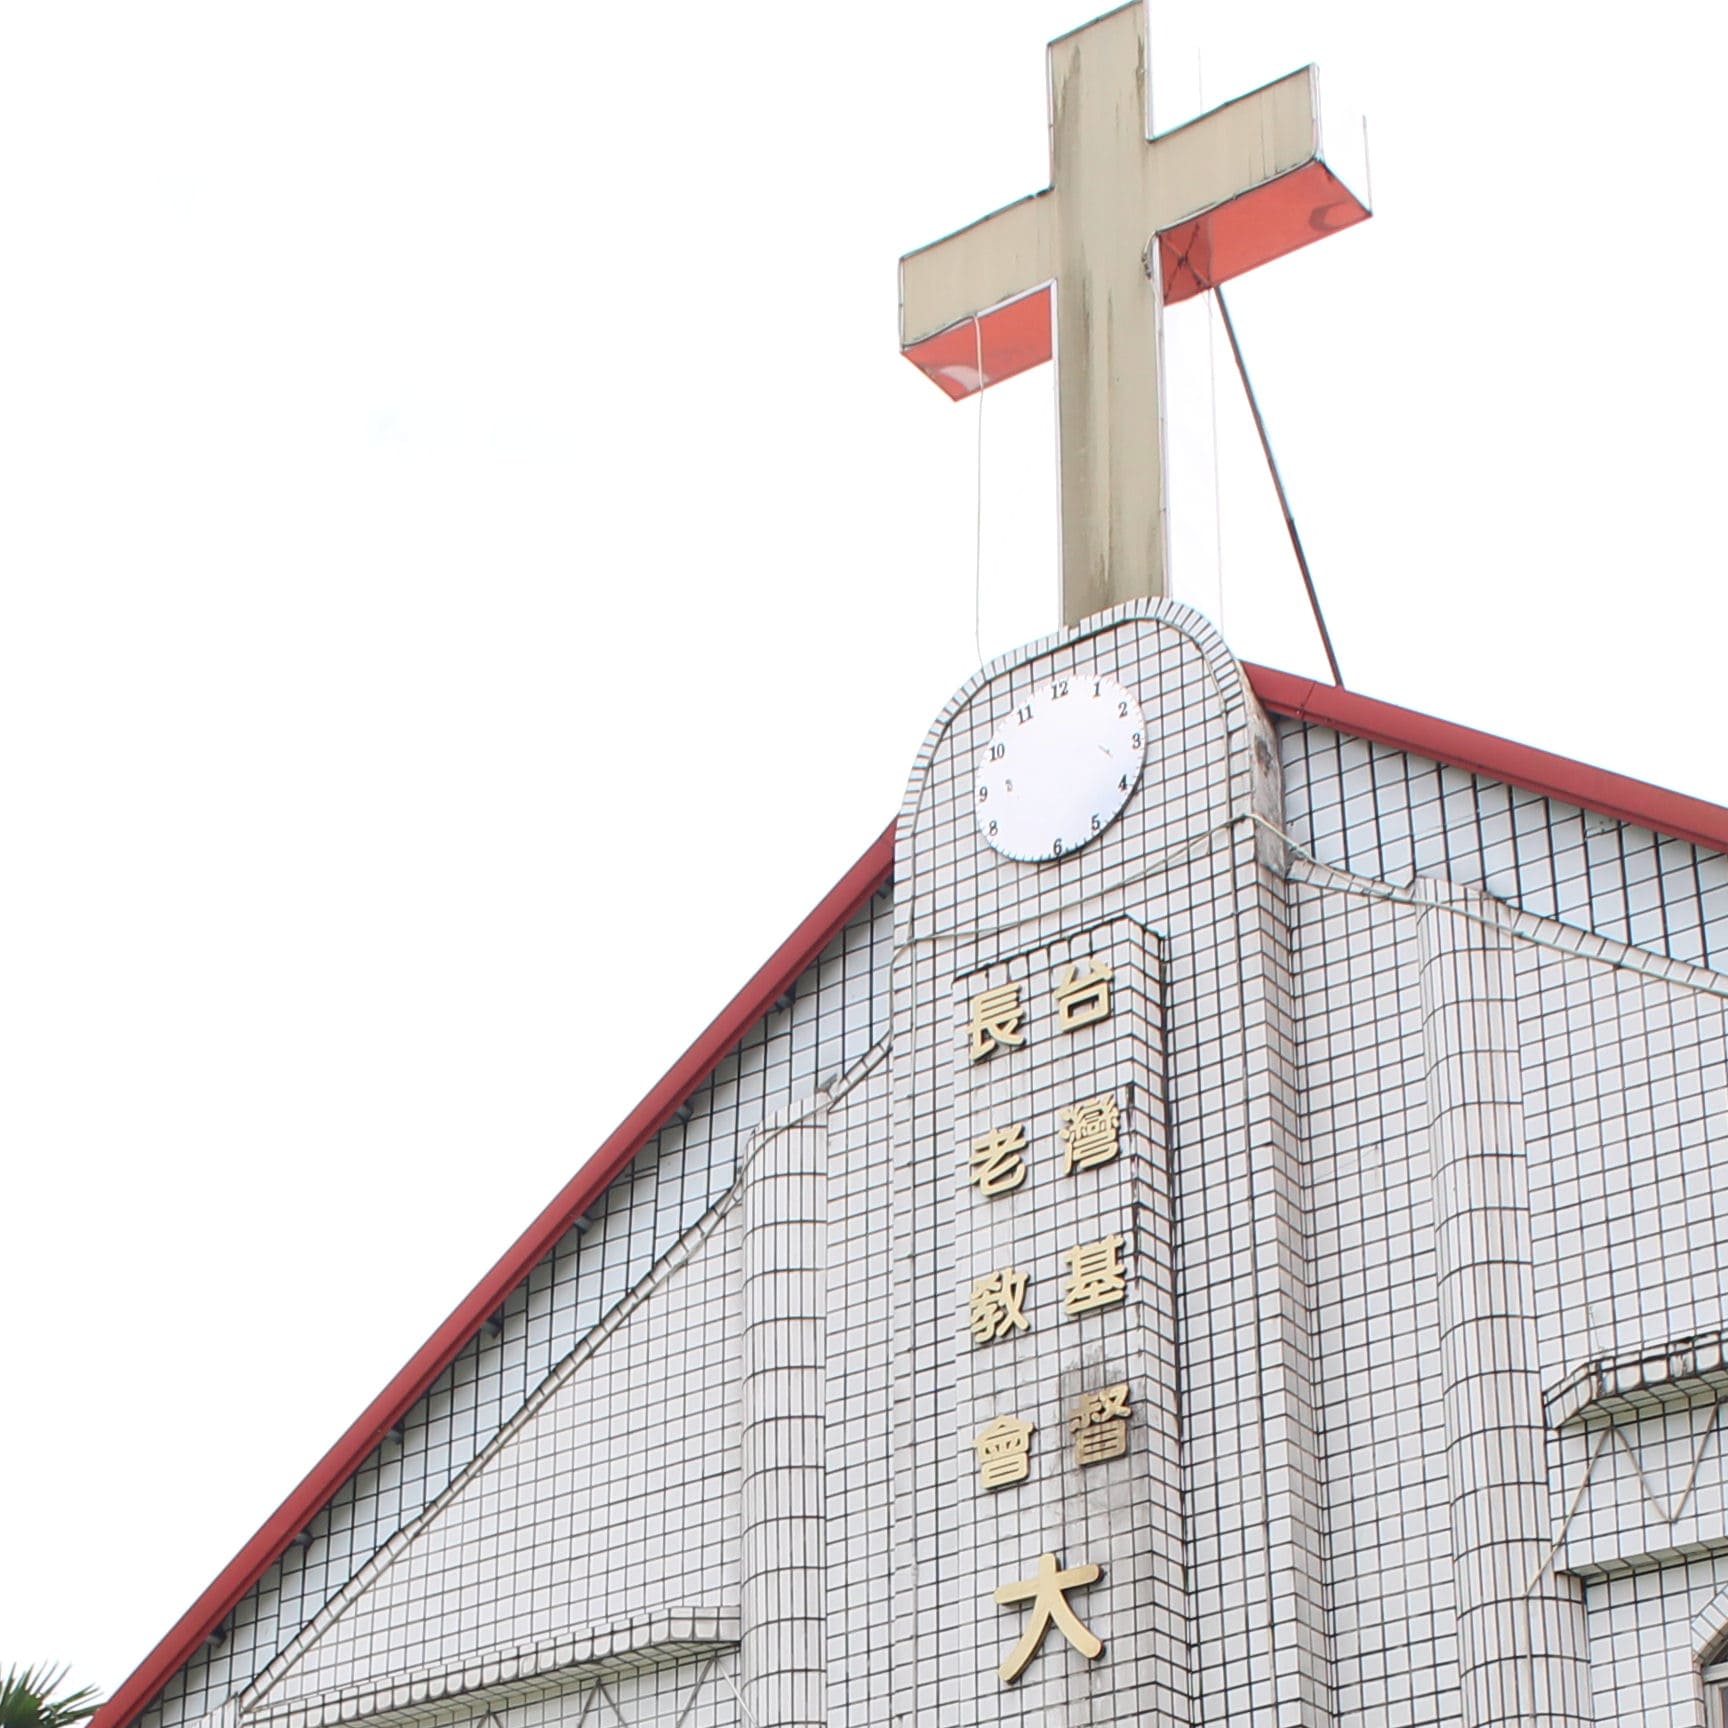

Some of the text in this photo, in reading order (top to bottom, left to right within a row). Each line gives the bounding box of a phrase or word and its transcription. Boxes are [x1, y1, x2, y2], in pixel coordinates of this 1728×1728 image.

[1052, 682, 1069, 700] 12
[1094, 683, 1102, 697] 1
[1019, 705, 1033, 724] 11
[1119, 703, 1128, 718] 2
[1132, 733, 1141, 749] 3
[990, 744, 1005, 761] 10
[1118, 774, 1128, 790] 4
[979, 786, 988, 803] 9
[989, 820, 998, 836] 8
[1091, 815, 1101, 830] 5
[1053, 840, 1062, 856] 6
[1053, 960, 1131, 1467] 台灣基督
